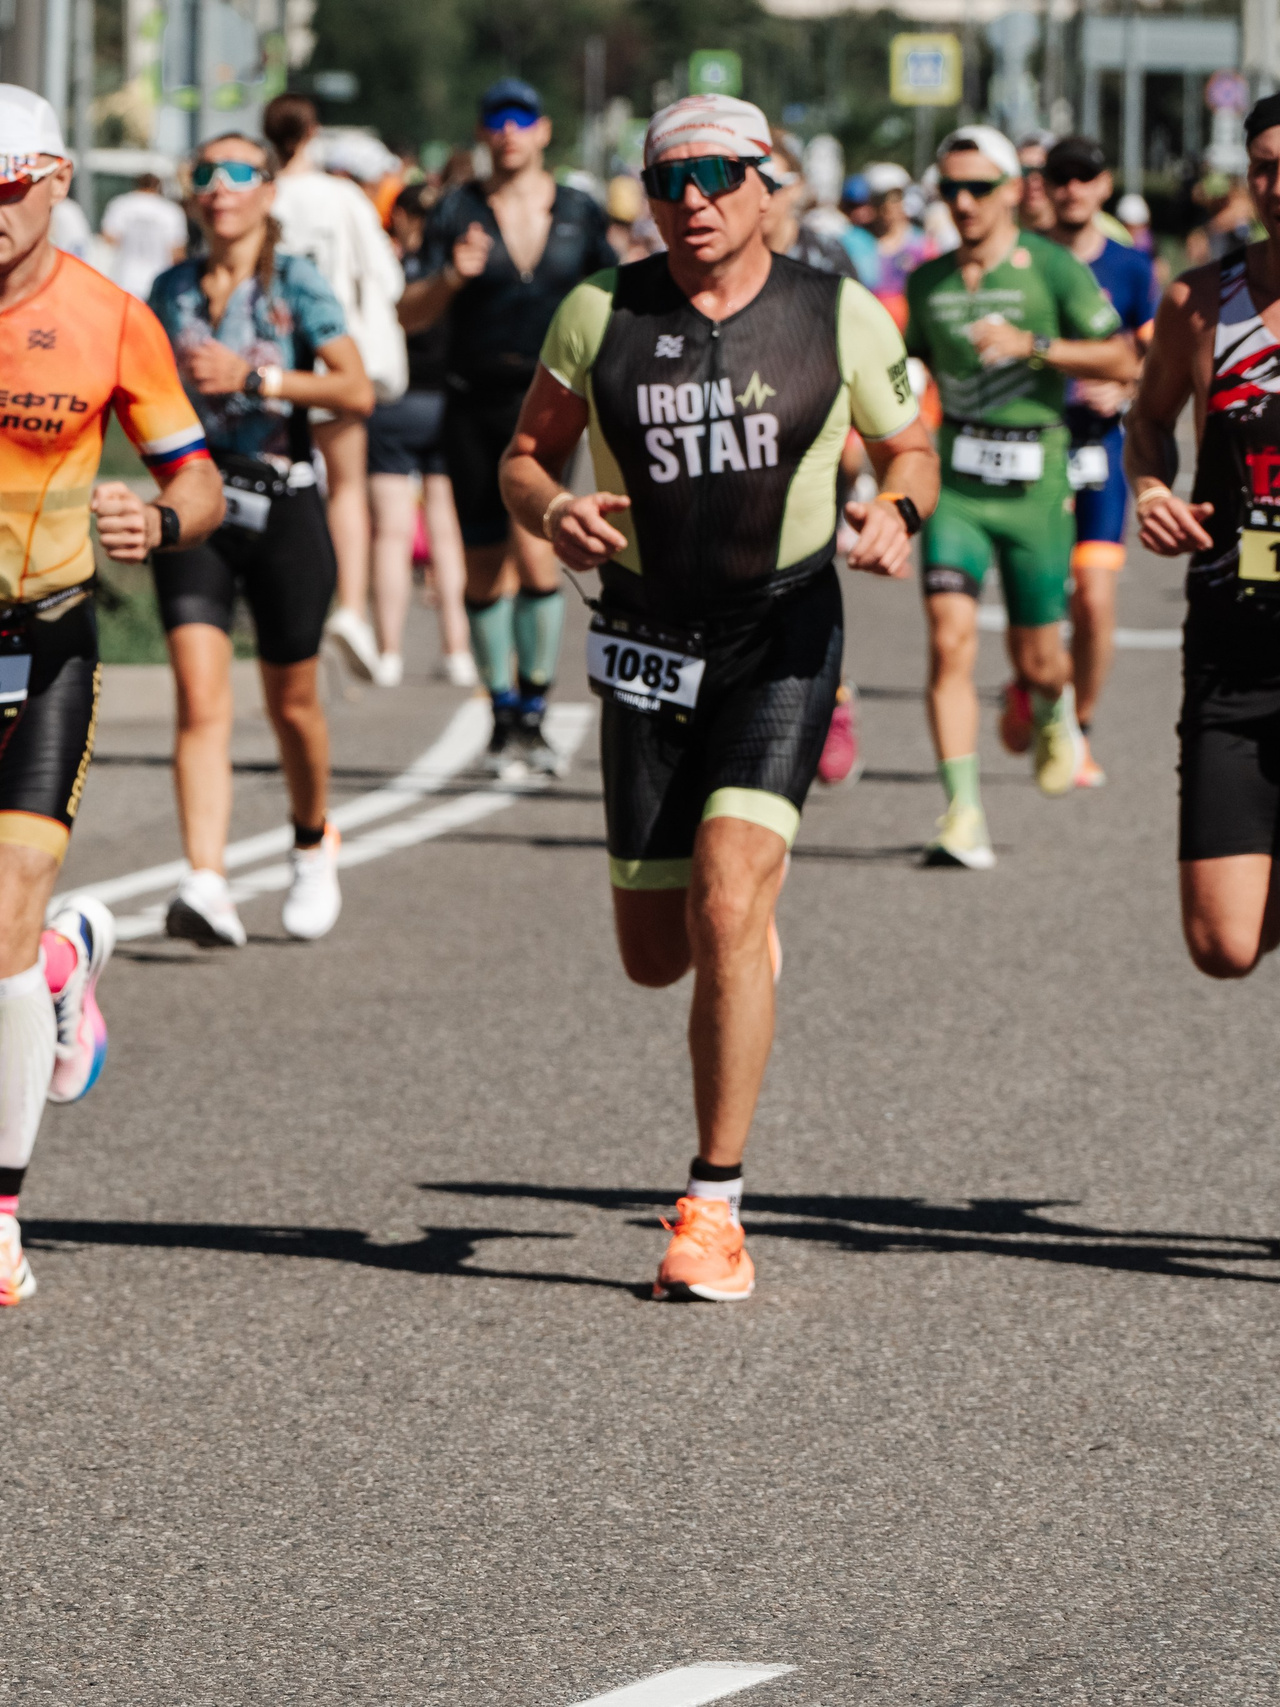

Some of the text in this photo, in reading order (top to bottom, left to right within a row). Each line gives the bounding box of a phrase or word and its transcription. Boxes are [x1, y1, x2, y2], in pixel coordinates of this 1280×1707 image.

[636, 377, 736, 425] IRON
[644, 412, 779, 483] STAR
[601, 643, 681, 694] 1085
